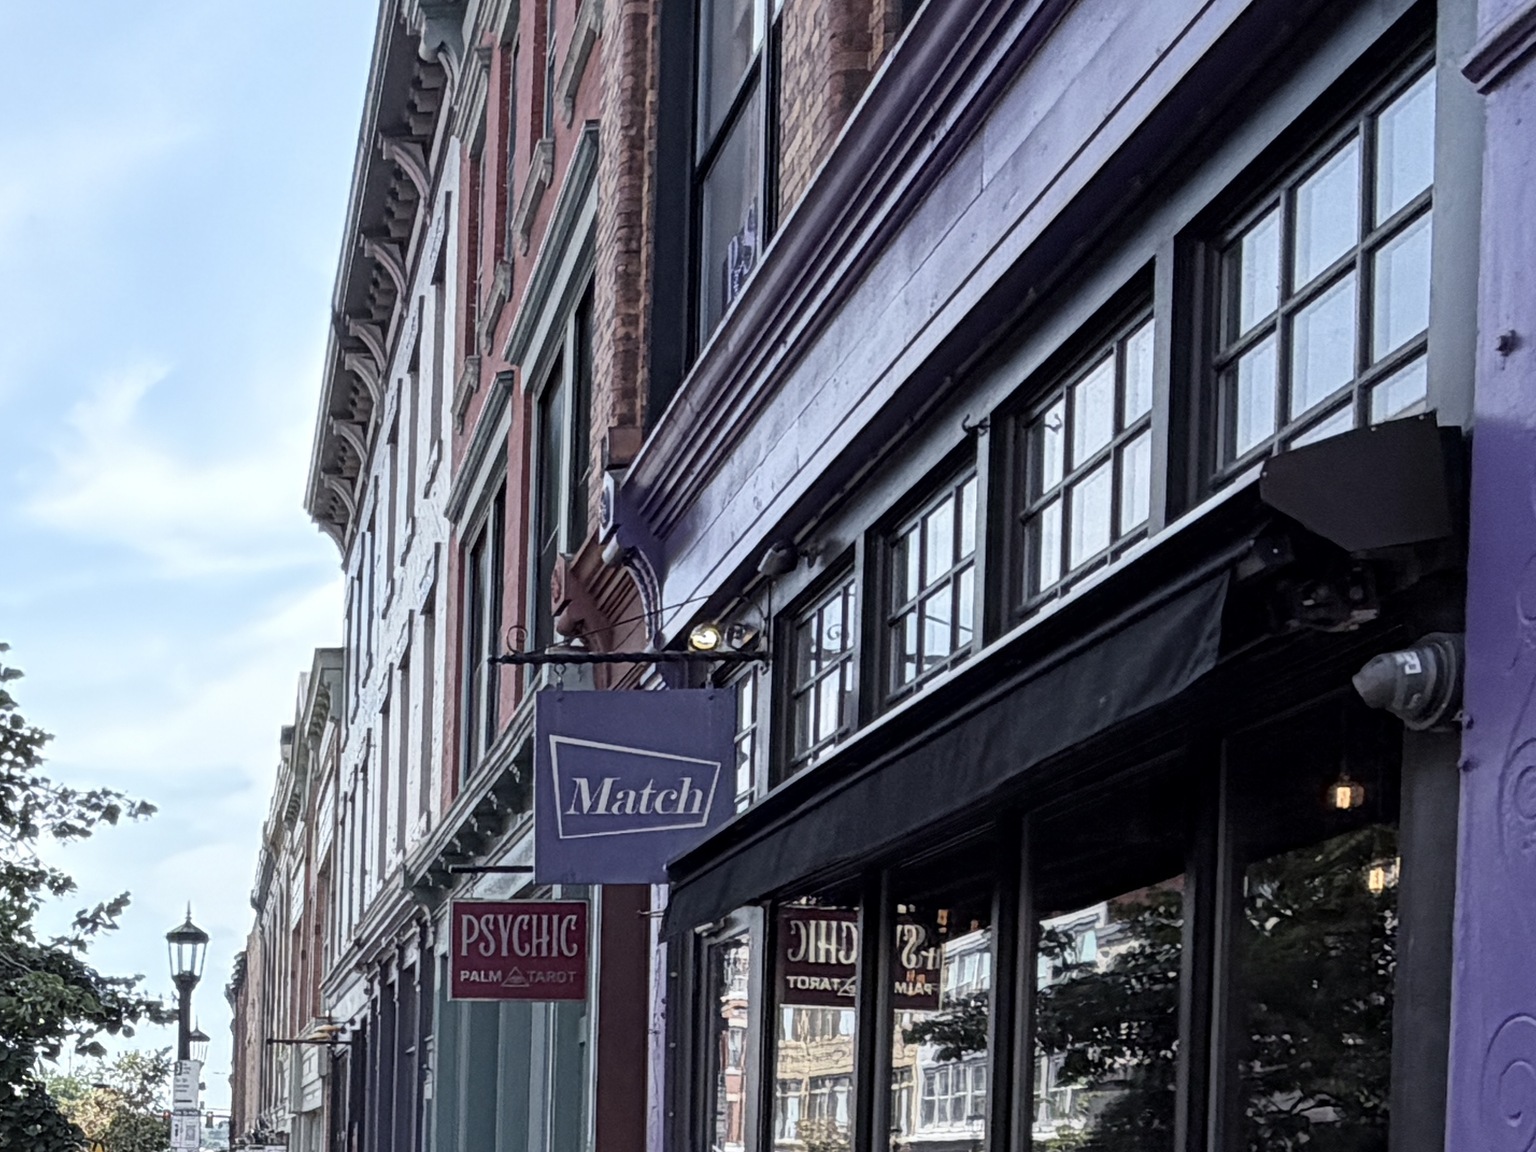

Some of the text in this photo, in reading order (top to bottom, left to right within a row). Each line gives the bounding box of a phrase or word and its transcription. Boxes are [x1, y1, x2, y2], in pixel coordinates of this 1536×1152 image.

[564, 777, 703, 815] Match
[460, 914, 579, 957] PSYCHIC
[460, 970, 577, 983] PALM TAROT
